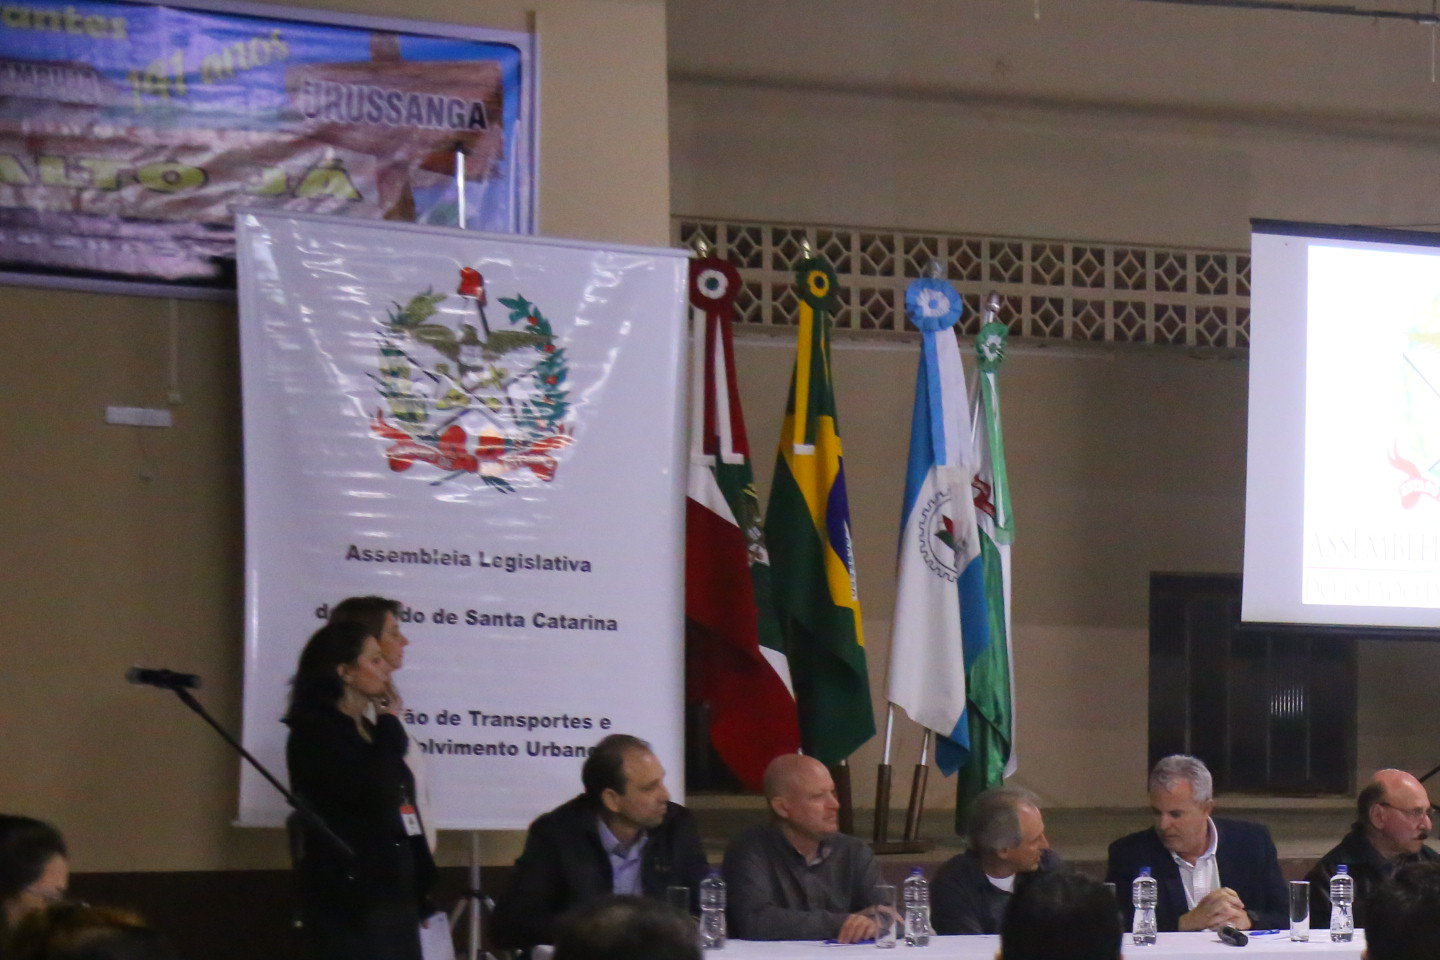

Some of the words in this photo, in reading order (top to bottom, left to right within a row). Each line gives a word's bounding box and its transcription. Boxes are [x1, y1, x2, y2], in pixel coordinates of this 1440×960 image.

[480, 551, 592, 573] Legislativa
[432, 608, 459, 625] de
[465, 609, 526, 628] Santa
[532, 611, 618, 632] Catarina
[436, 709, 462, 726] de
[468, 710, 593, 731] Transportes
[600, 718, 612, 730] e
